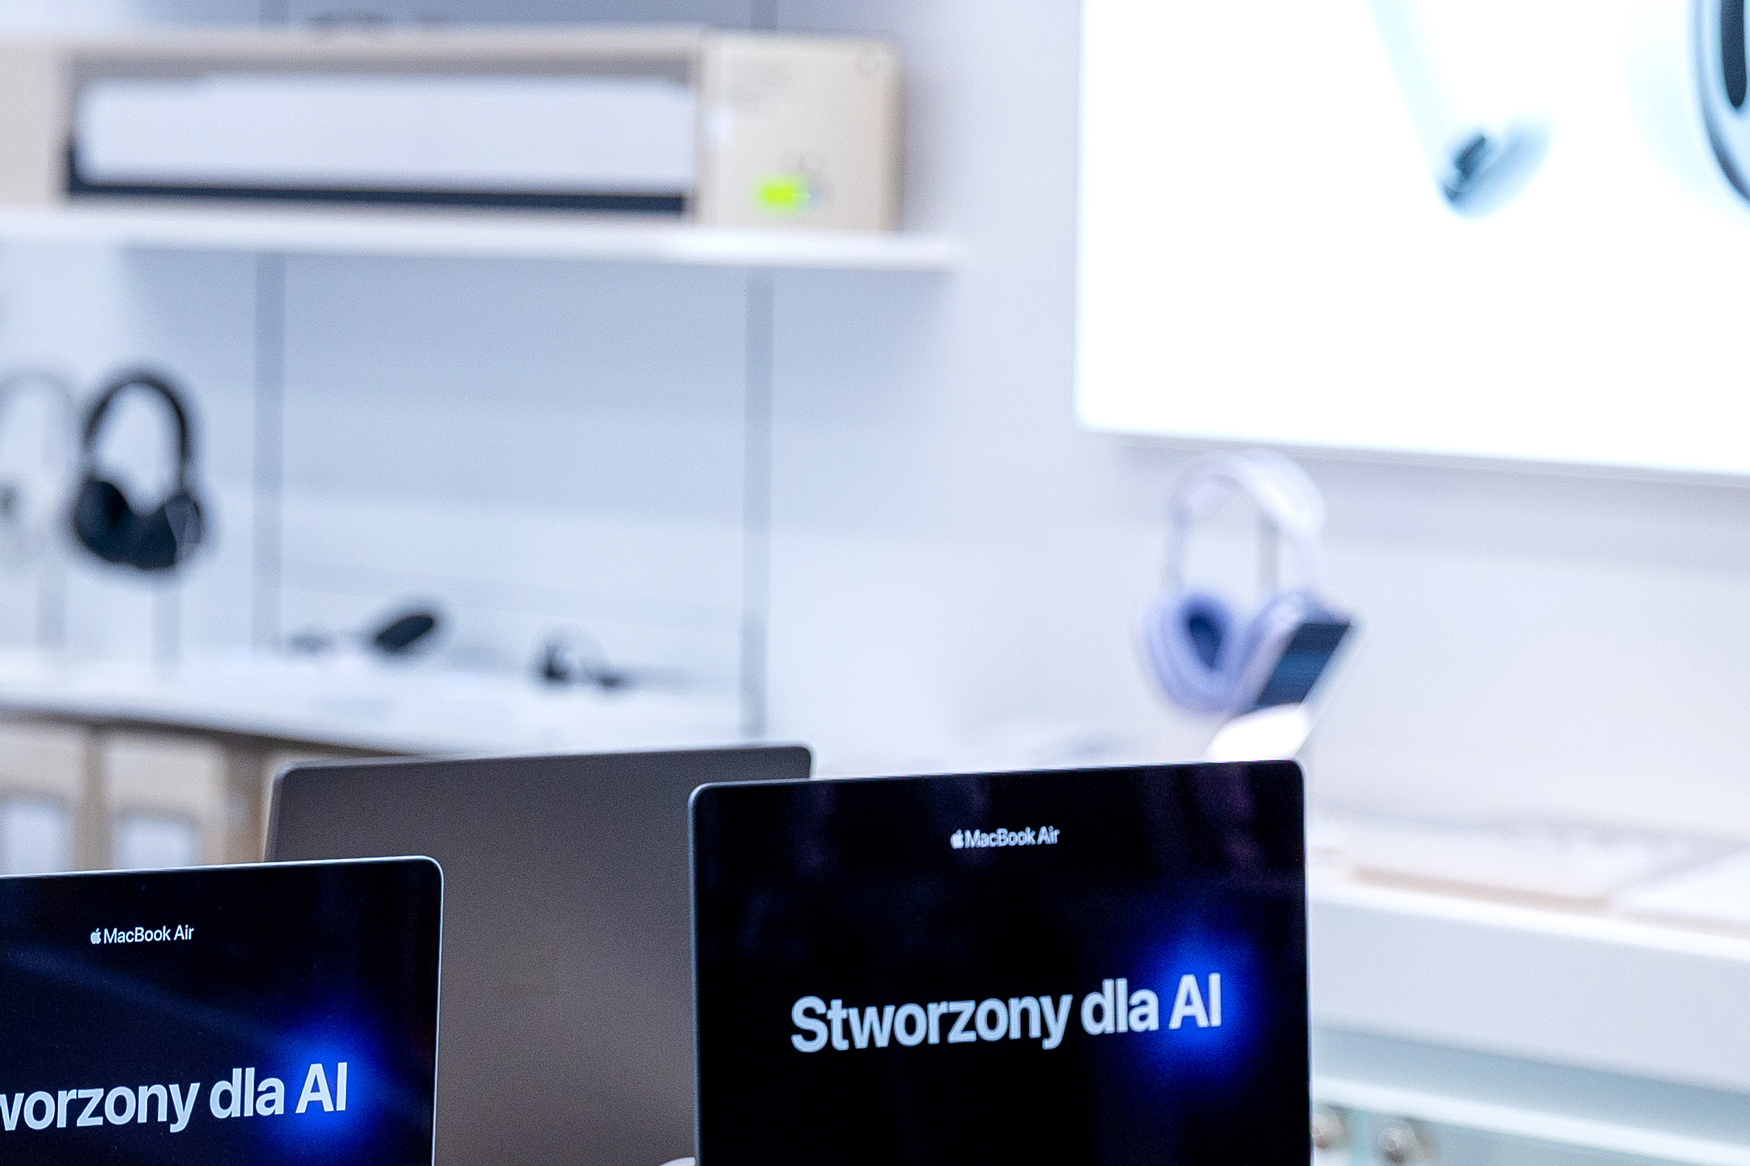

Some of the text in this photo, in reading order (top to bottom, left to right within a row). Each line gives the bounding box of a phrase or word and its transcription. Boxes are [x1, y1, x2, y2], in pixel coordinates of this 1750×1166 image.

[965, 825, 1060, 849] MacBook Air
[103, 924, 195, 944] MacBook Air
[791, 972, 1222, 1053] Stworzony dla AI
[209, 1067, 286, 1119] dla
[295, 1061, 348, 1114] AI
